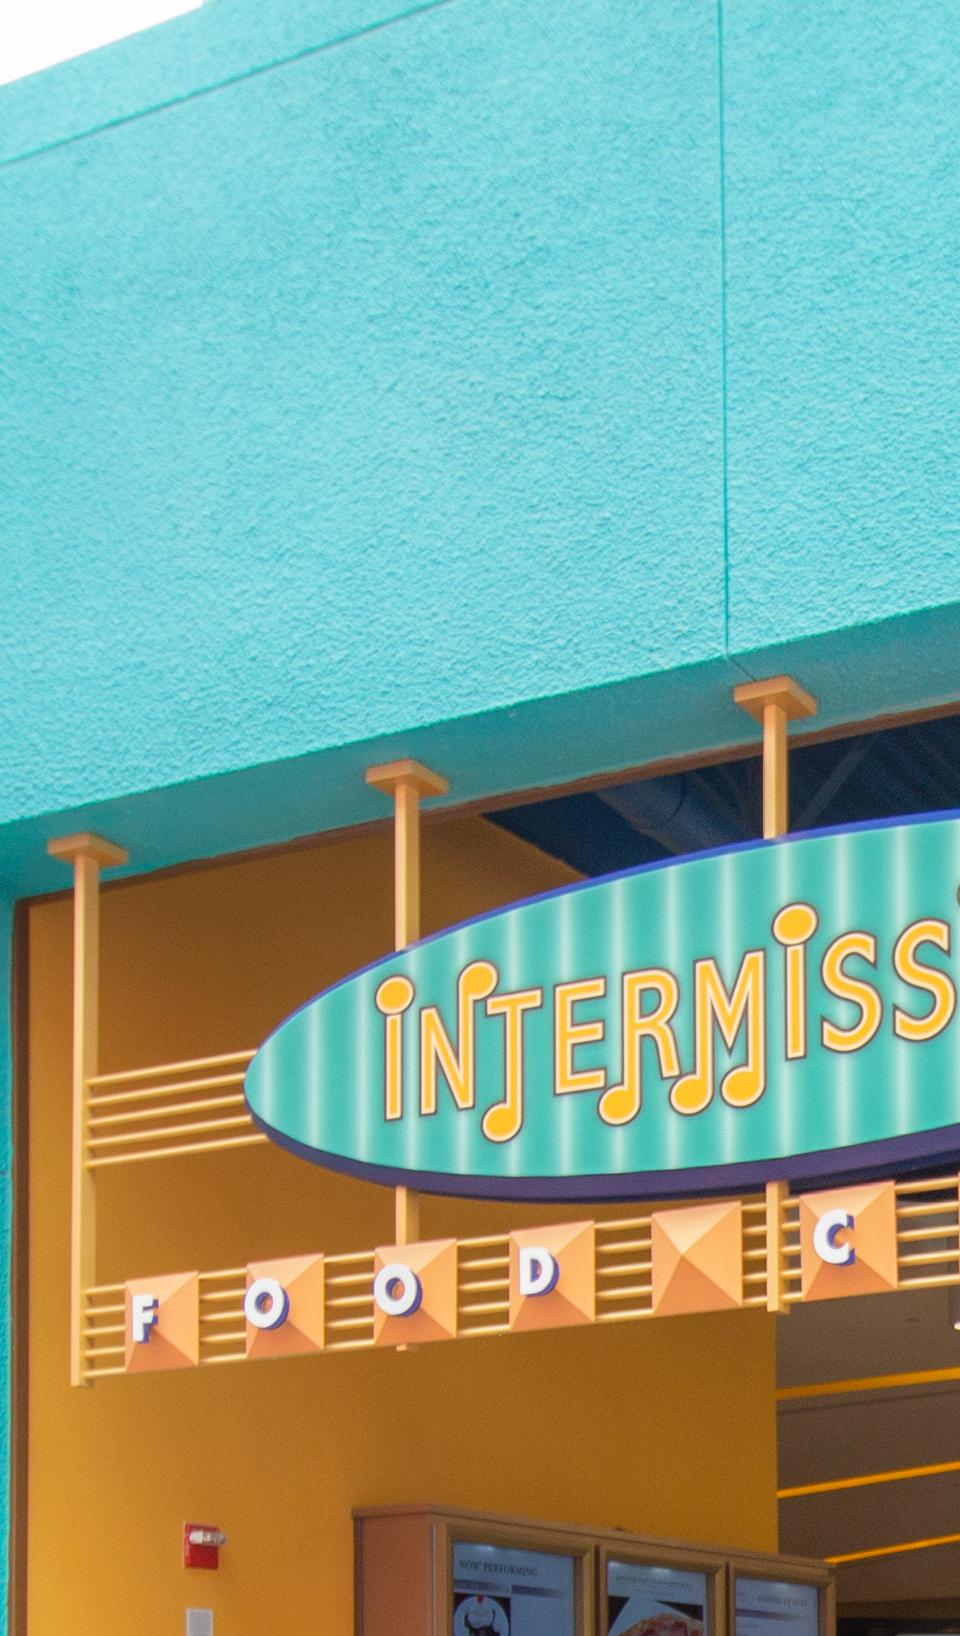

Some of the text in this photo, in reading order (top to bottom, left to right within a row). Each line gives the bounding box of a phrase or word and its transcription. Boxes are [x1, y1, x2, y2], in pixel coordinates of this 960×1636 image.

[130, 1244, 560, 1343] FOOD
[458, 1559, 539, 1578] NOW PERFORMING
